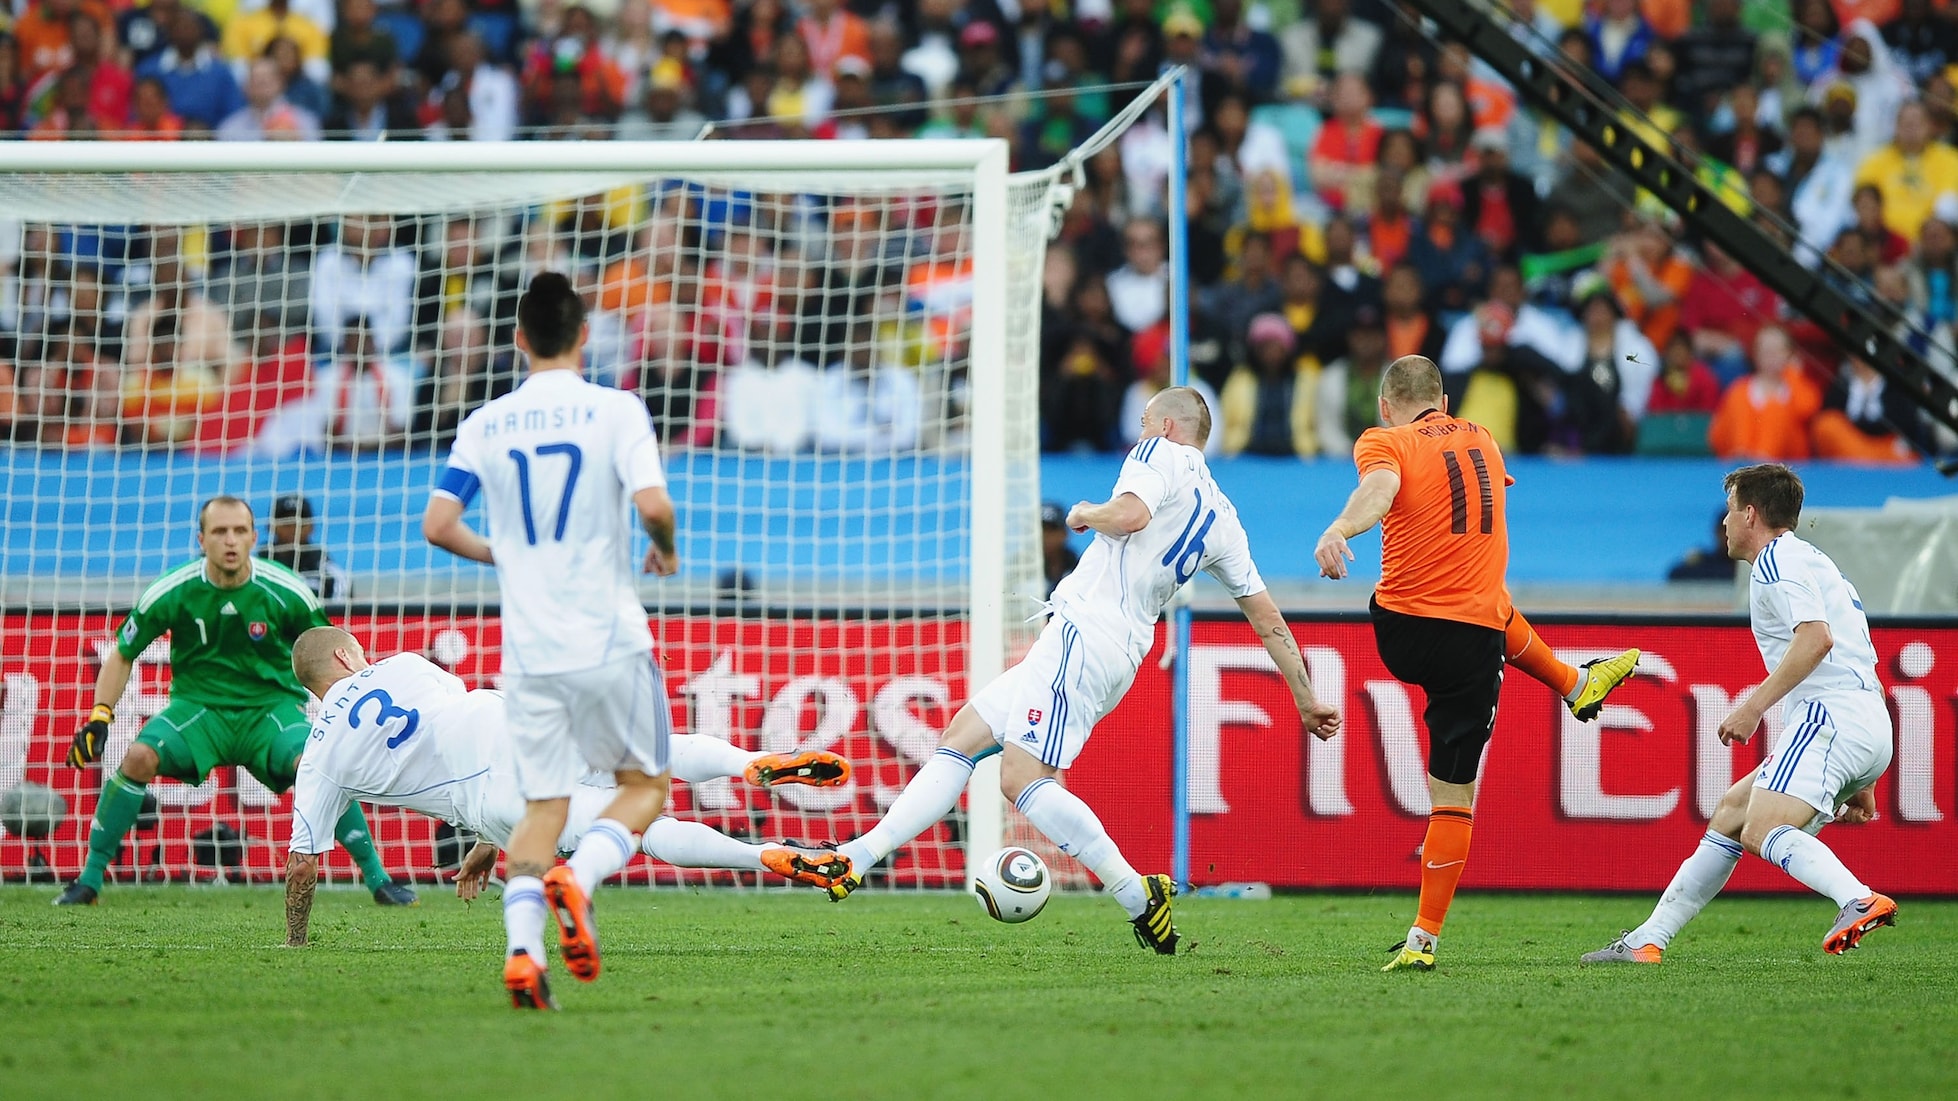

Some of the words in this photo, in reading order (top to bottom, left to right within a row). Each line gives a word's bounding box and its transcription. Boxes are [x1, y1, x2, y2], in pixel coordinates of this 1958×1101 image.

[484, 405, 597, 438] HAMSIK
[509, 442, 582, 546] 17
[1442, 448, 1494, 535] 11
[1161, 487, 1217, 585] 16
[195, 617, 208, 645] 1
[348, 688, 420, 750] 3
